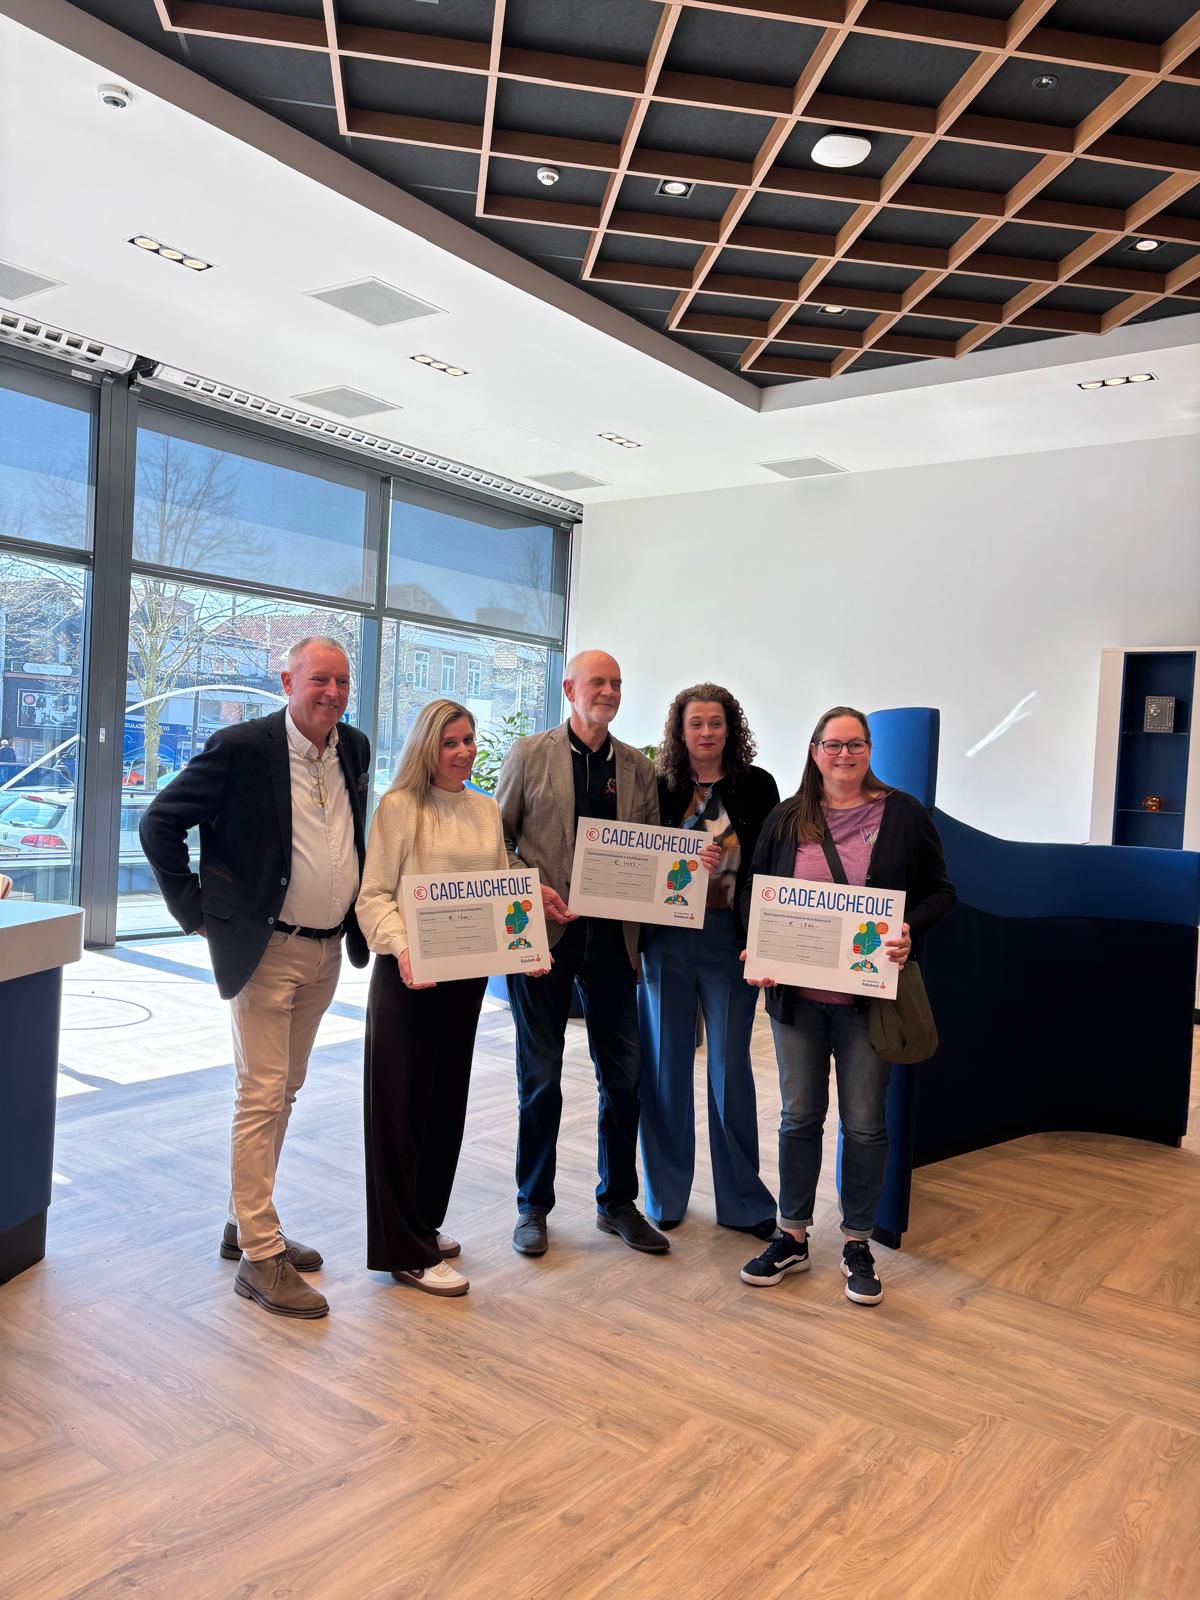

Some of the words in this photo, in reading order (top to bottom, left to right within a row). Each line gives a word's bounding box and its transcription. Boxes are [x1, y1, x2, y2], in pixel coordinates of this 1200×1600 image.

[601, 827, 704, 856] CADEAUCHEQUE
[430, 876, 533, 901] CADEAUCHEQUE
[778, 886, 895, 917] CADEAUCHEQUE
